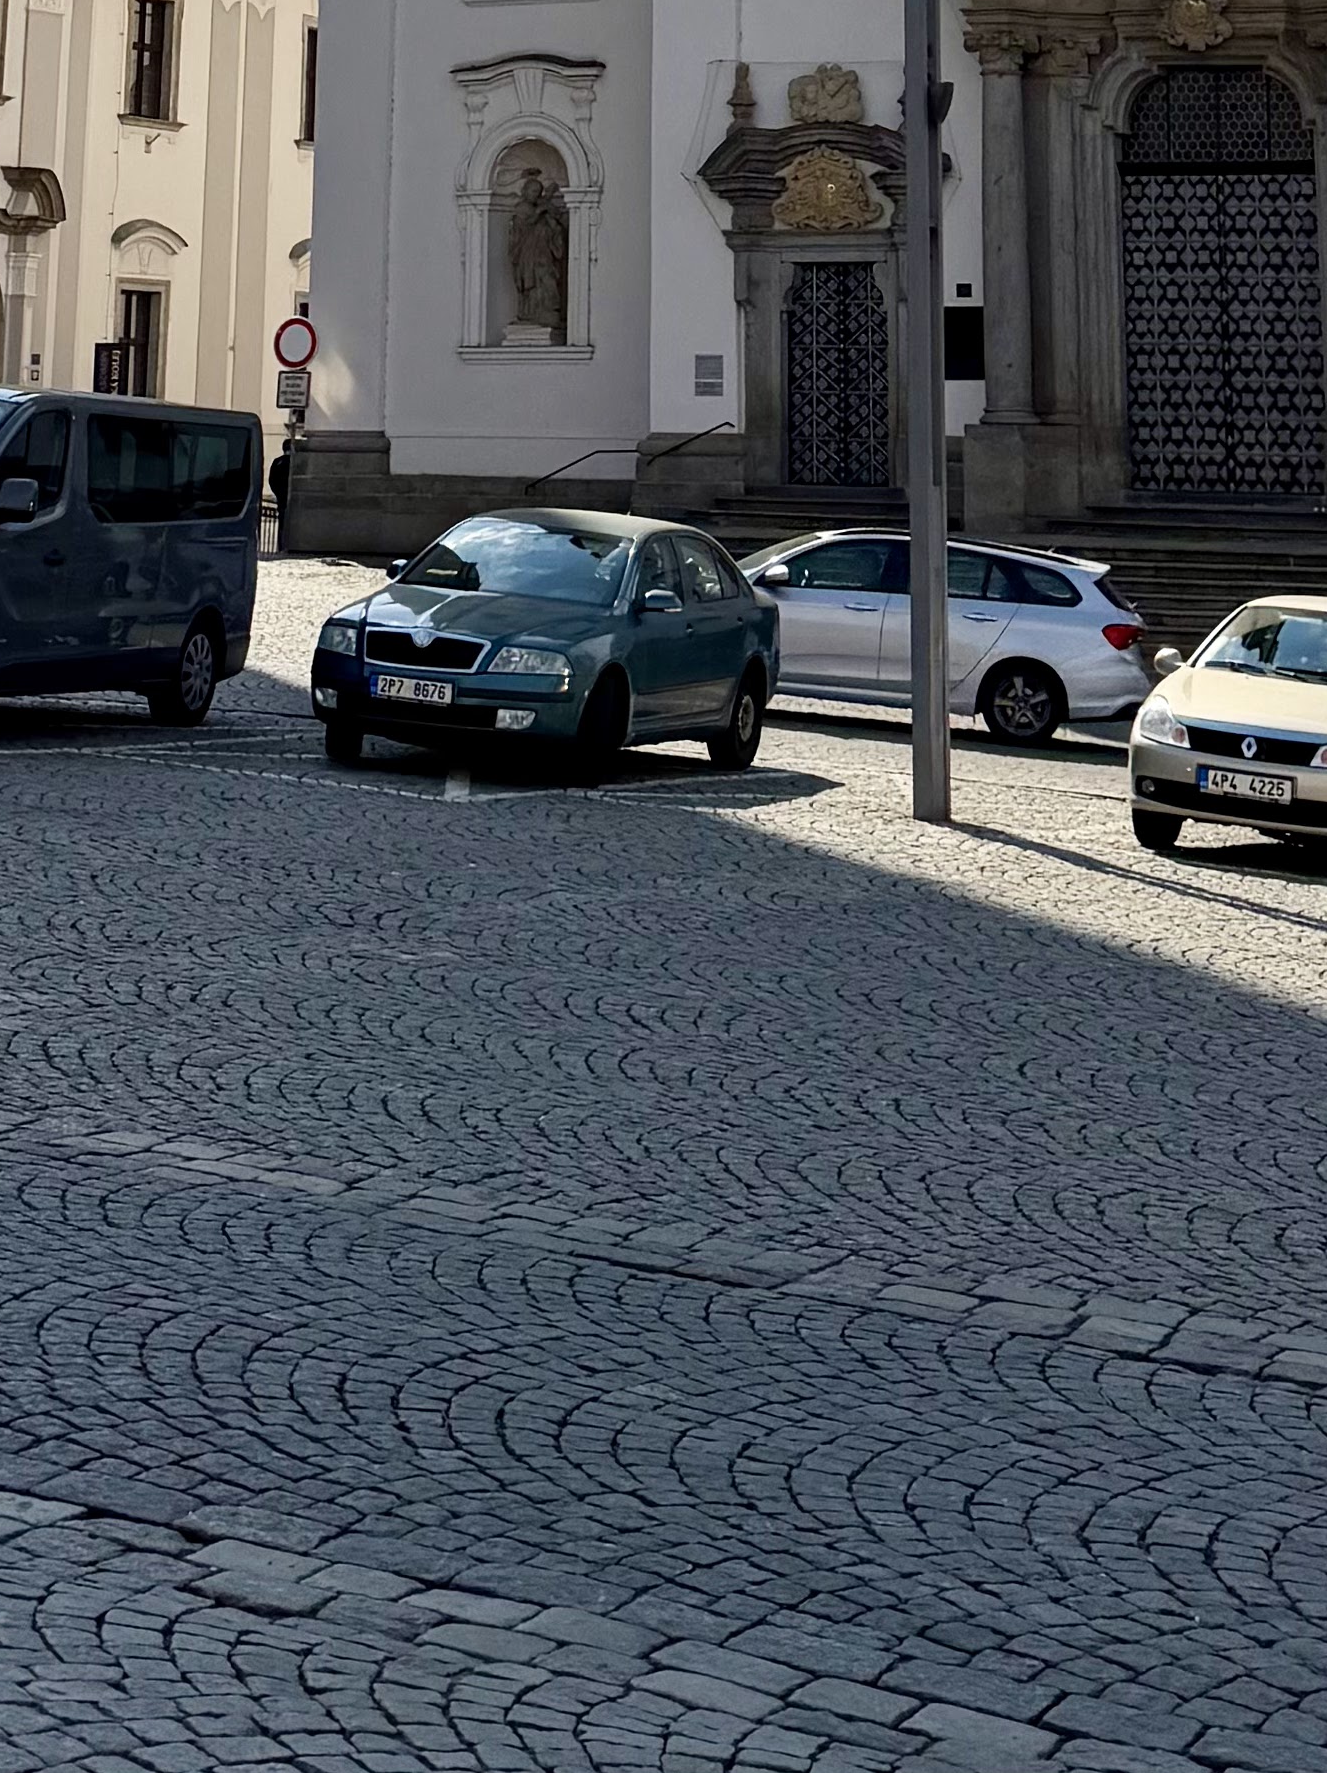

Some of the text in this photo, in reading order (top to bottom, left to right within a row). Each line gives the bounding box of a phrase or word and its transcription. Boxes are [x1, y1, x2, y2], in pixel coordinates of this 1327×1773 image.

[380, 677, 446, 701] 2P7 8676
[1211, 772, 1238, 791] 4P4
